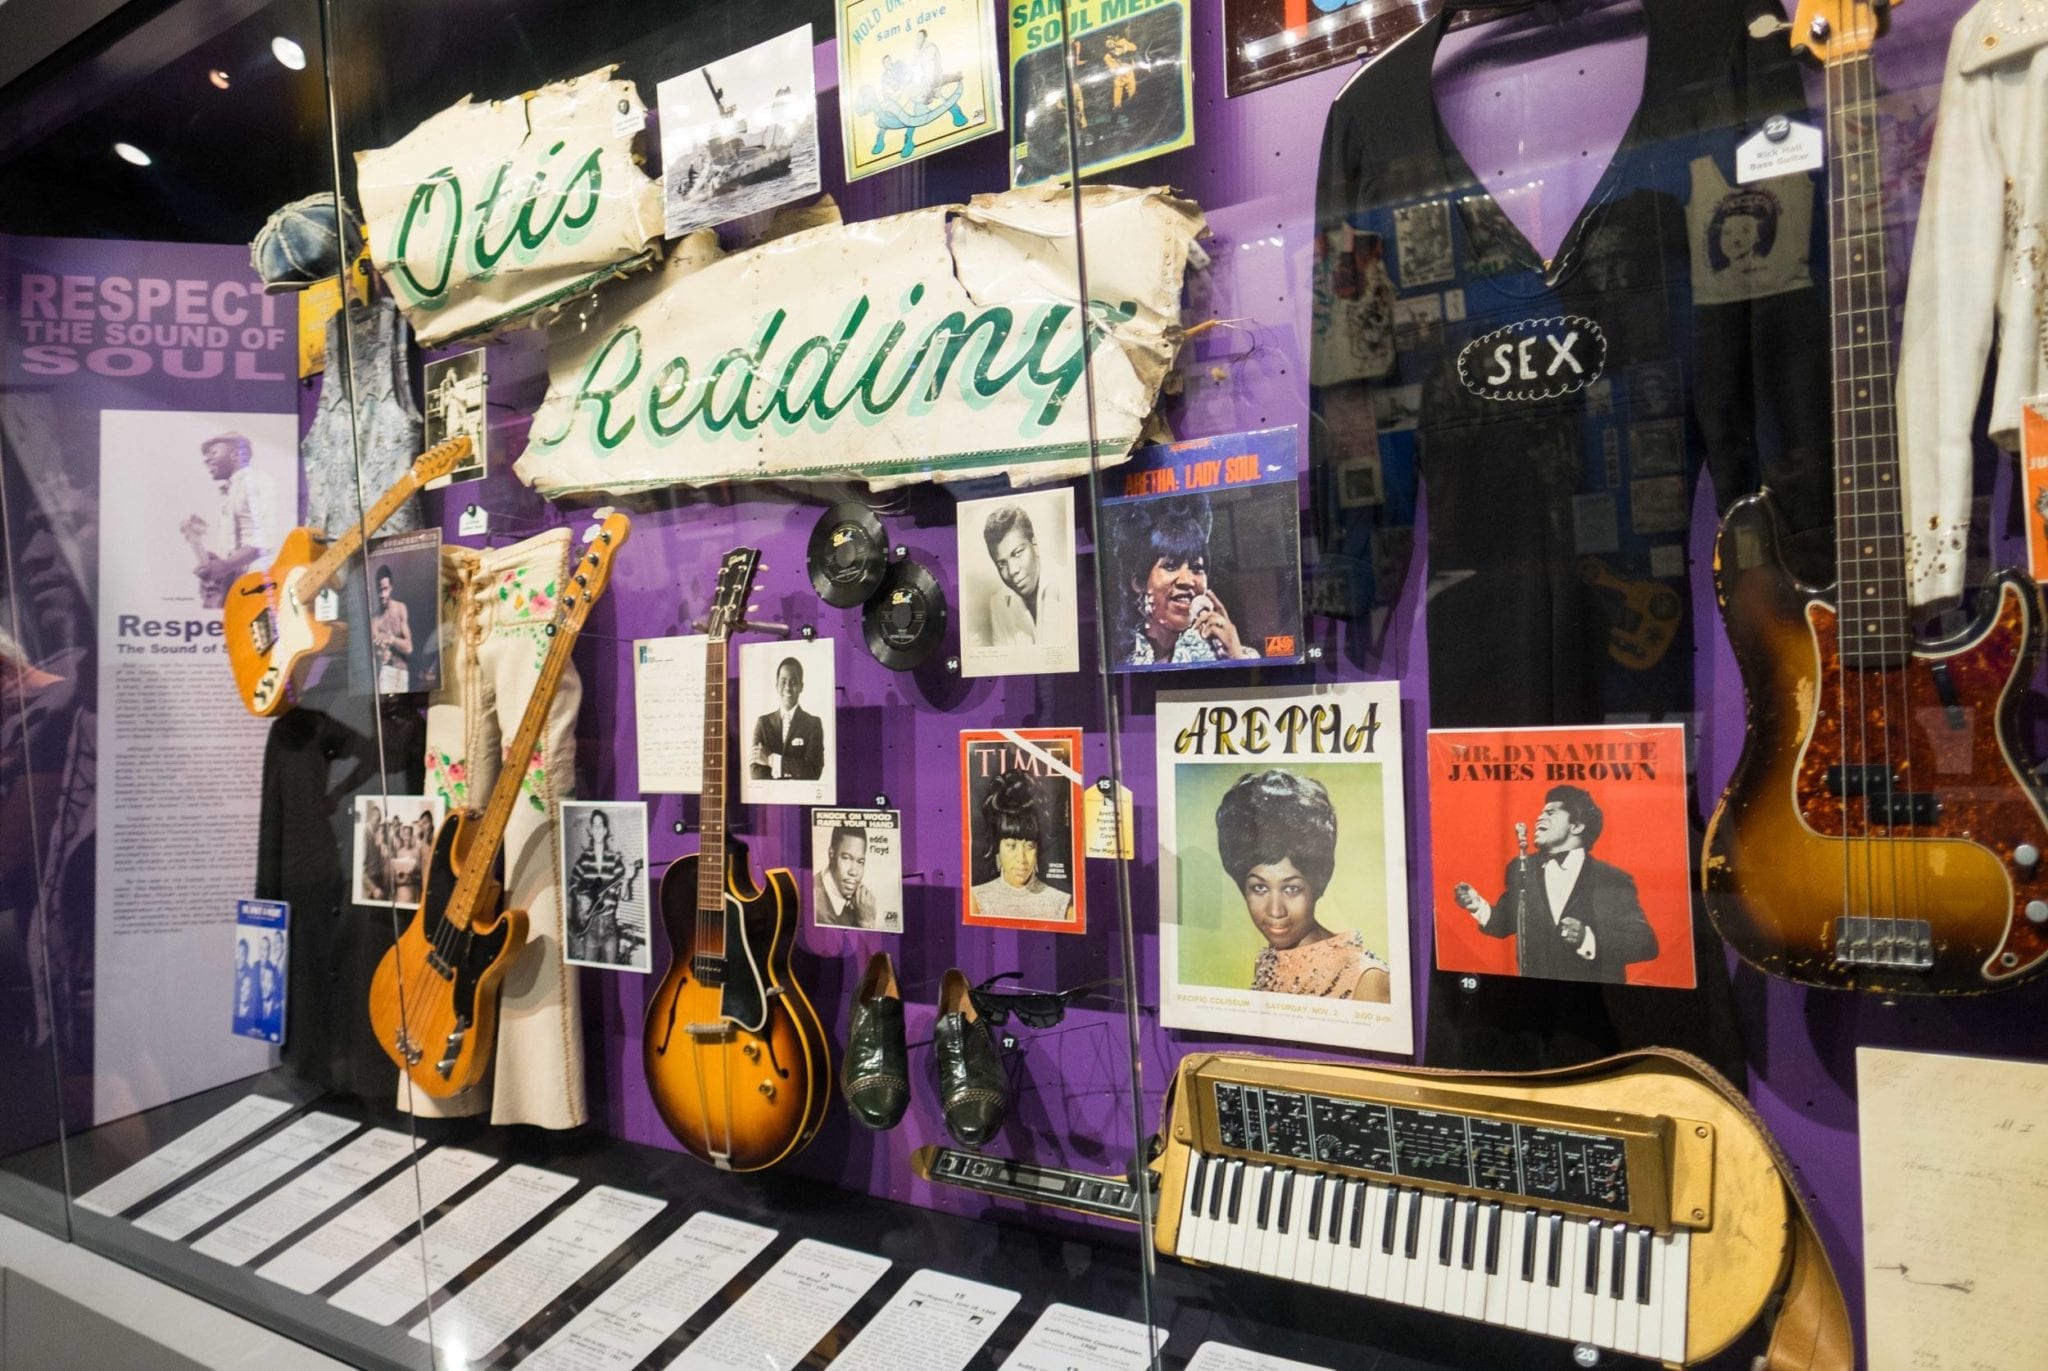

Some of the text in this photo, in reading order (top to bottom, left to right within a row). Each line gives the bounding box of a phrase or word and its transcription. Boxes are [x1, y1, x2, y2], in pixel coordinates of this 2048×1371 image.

[852, 8, 881, 45] HOLD
[877, 5, 946, 42] sam & dave
[1766, 120, 1789, 135] 22
[391, 140, 605, 306] Otis
[20, 274, 277, 327] RESPECT
[20, 320, 286, 350] THE SOUND OF
[21, 345, 286, 381] SOUL
[538, 282, 1139, 455] Redding
[1487, 331, 1584, 386] SEX
[1184, 459, 1222, 490] LADY
[1225, 454, 1262, 484] SOUL
[118, 614, 224, 642] Respe
[117, 643, 145, 654] The
[151, 644, 197, 654] Sound
[202, 643, 217, 653] of
[1308, 647, 1322, 658] 16
[1174, 702, 1381, 755] ARETHA
[974, 748, 1065, 777] TIME
[1451, 742, 1657, 762] MR. DYNAMITE
[1099, 780, 1110, 789] 15
[1448, 763, 1657, 781] JAMES BROWN
[1460, 977, 1477, 989] 19
[1003, 1038, 1014, 1048] 17
[1577, 1347, 1597, 1361] 20
